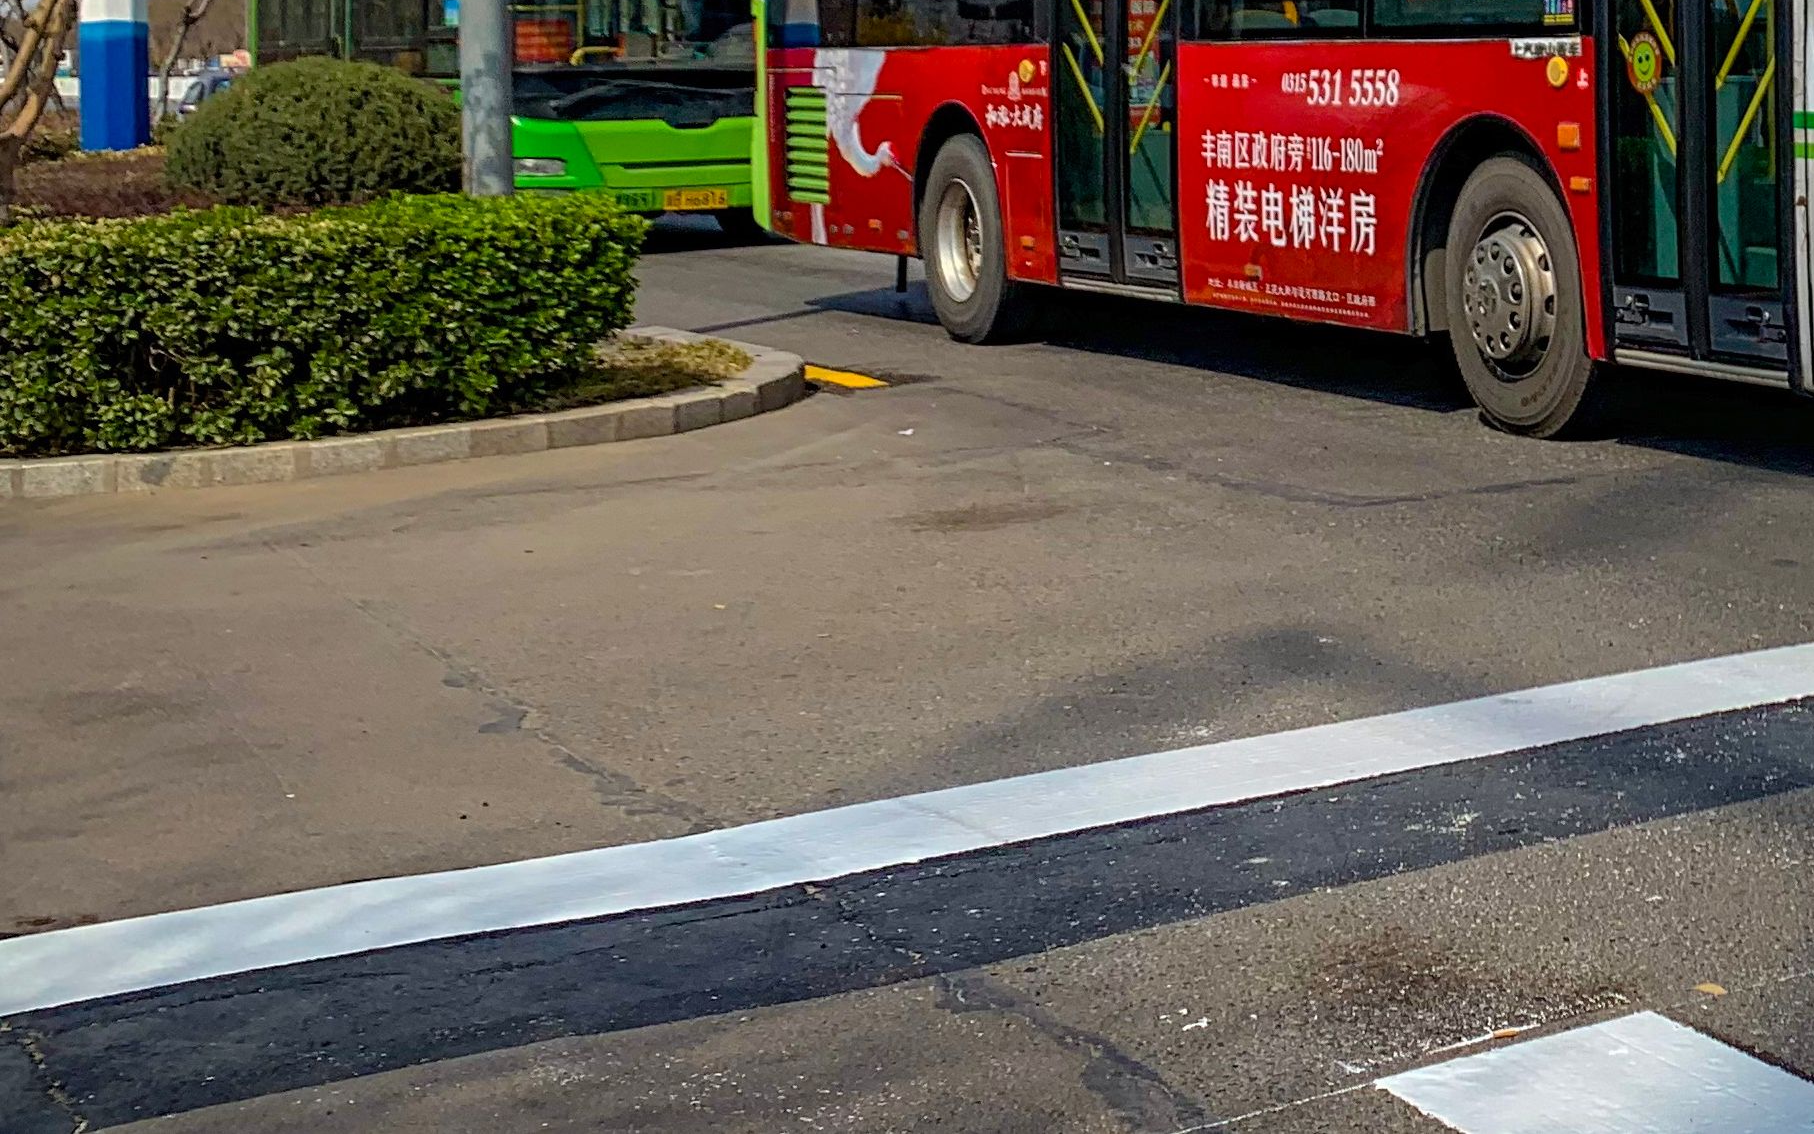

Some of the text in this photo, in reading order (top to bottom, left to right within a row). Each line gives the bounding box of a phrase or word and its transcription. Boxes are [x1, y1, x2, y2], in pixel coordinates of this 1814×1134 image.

[1281, 73, 1307, 93] 0315
[1307, 69, 1343, 106] 531
[1349, 69, 1400, 106] 5558
[1201, 129, 1305, 172] 丰南区政府旁
[1206, 178, 1378, 256] 精装电梯洋房
